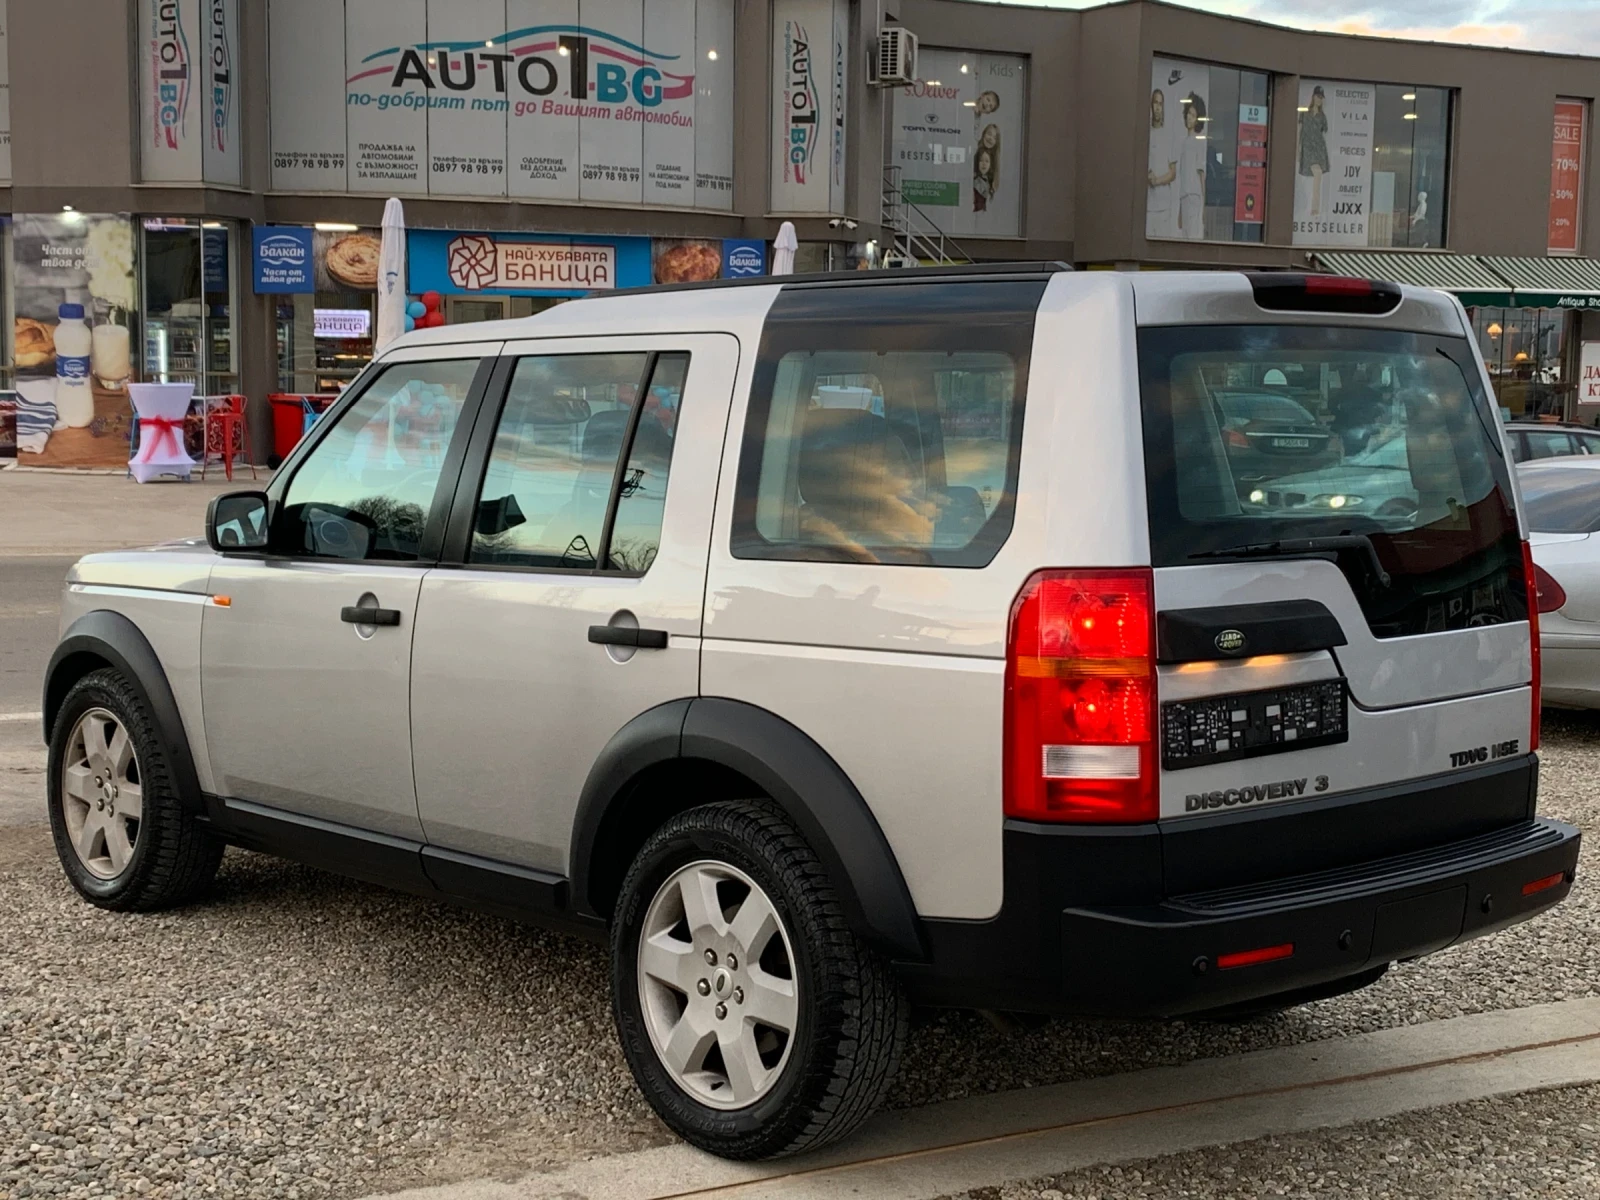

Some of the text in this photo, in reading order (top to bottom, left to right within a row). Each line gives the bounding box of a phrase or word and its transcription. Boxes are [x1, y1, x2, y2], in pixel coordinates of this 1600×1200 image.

[160, 0, 187, 126] UTO1BG
[213, 0, 230, 128] UTO1BG
[990, 63, 1014, 78] Kids
[1335, 90, 1369, 99] SELECTED
[347, 91, 693, 127] по-добрият път до Вашият автомобил
[1341, 112, 1368, 121] VILA
[1554, 126, 1579, 141] SALE
[358, 143, 403, 152] ПРОДАЖБА
[361, 153, 414, 161] АВТОМОБИЛИ
[522, 157, 563, 165] ОДОБРЕНИЕ
[274, 158, 344, 169] 0897 98 98 99
[364, 162, 418, 171] ВЪЗМОЖНОСТ
[432, 163, 503, 174] 0897 98 98 99
[533, 165, 567, 173] ДОКАЗАН
[370, 171, 418, 180] ИЗПЛАЩАНЕ
[530, 172, 558, 180] ДОХОД
[583, 170, 640, 182] 0897 98 98 99
[1344, 166, 1361, 178] JDY
[1332, 202, 1362, 215] JJXX
[1293, 222, 1363, 234] BESTSELLER
[42, 244, 73, 255] Част
[260, 245, 305, 257] Балкан
[505, 247, 608, 263] НАЙ-ХУБАВАТА
[41, 257, 73, 267] твоя
[730, 256, 761, 266] Балкан
[263, 267, 287, 276] Част
[505, 263, 608, 286] БАНИЦА
[261, 275, 305, 285] твоя ден!
[1556, 296, 1585, 308] Antique
[1449, 739, 1519, 768] TDV6 HSE
[1185, 775, 1329, 812] DISCOVERY 3
